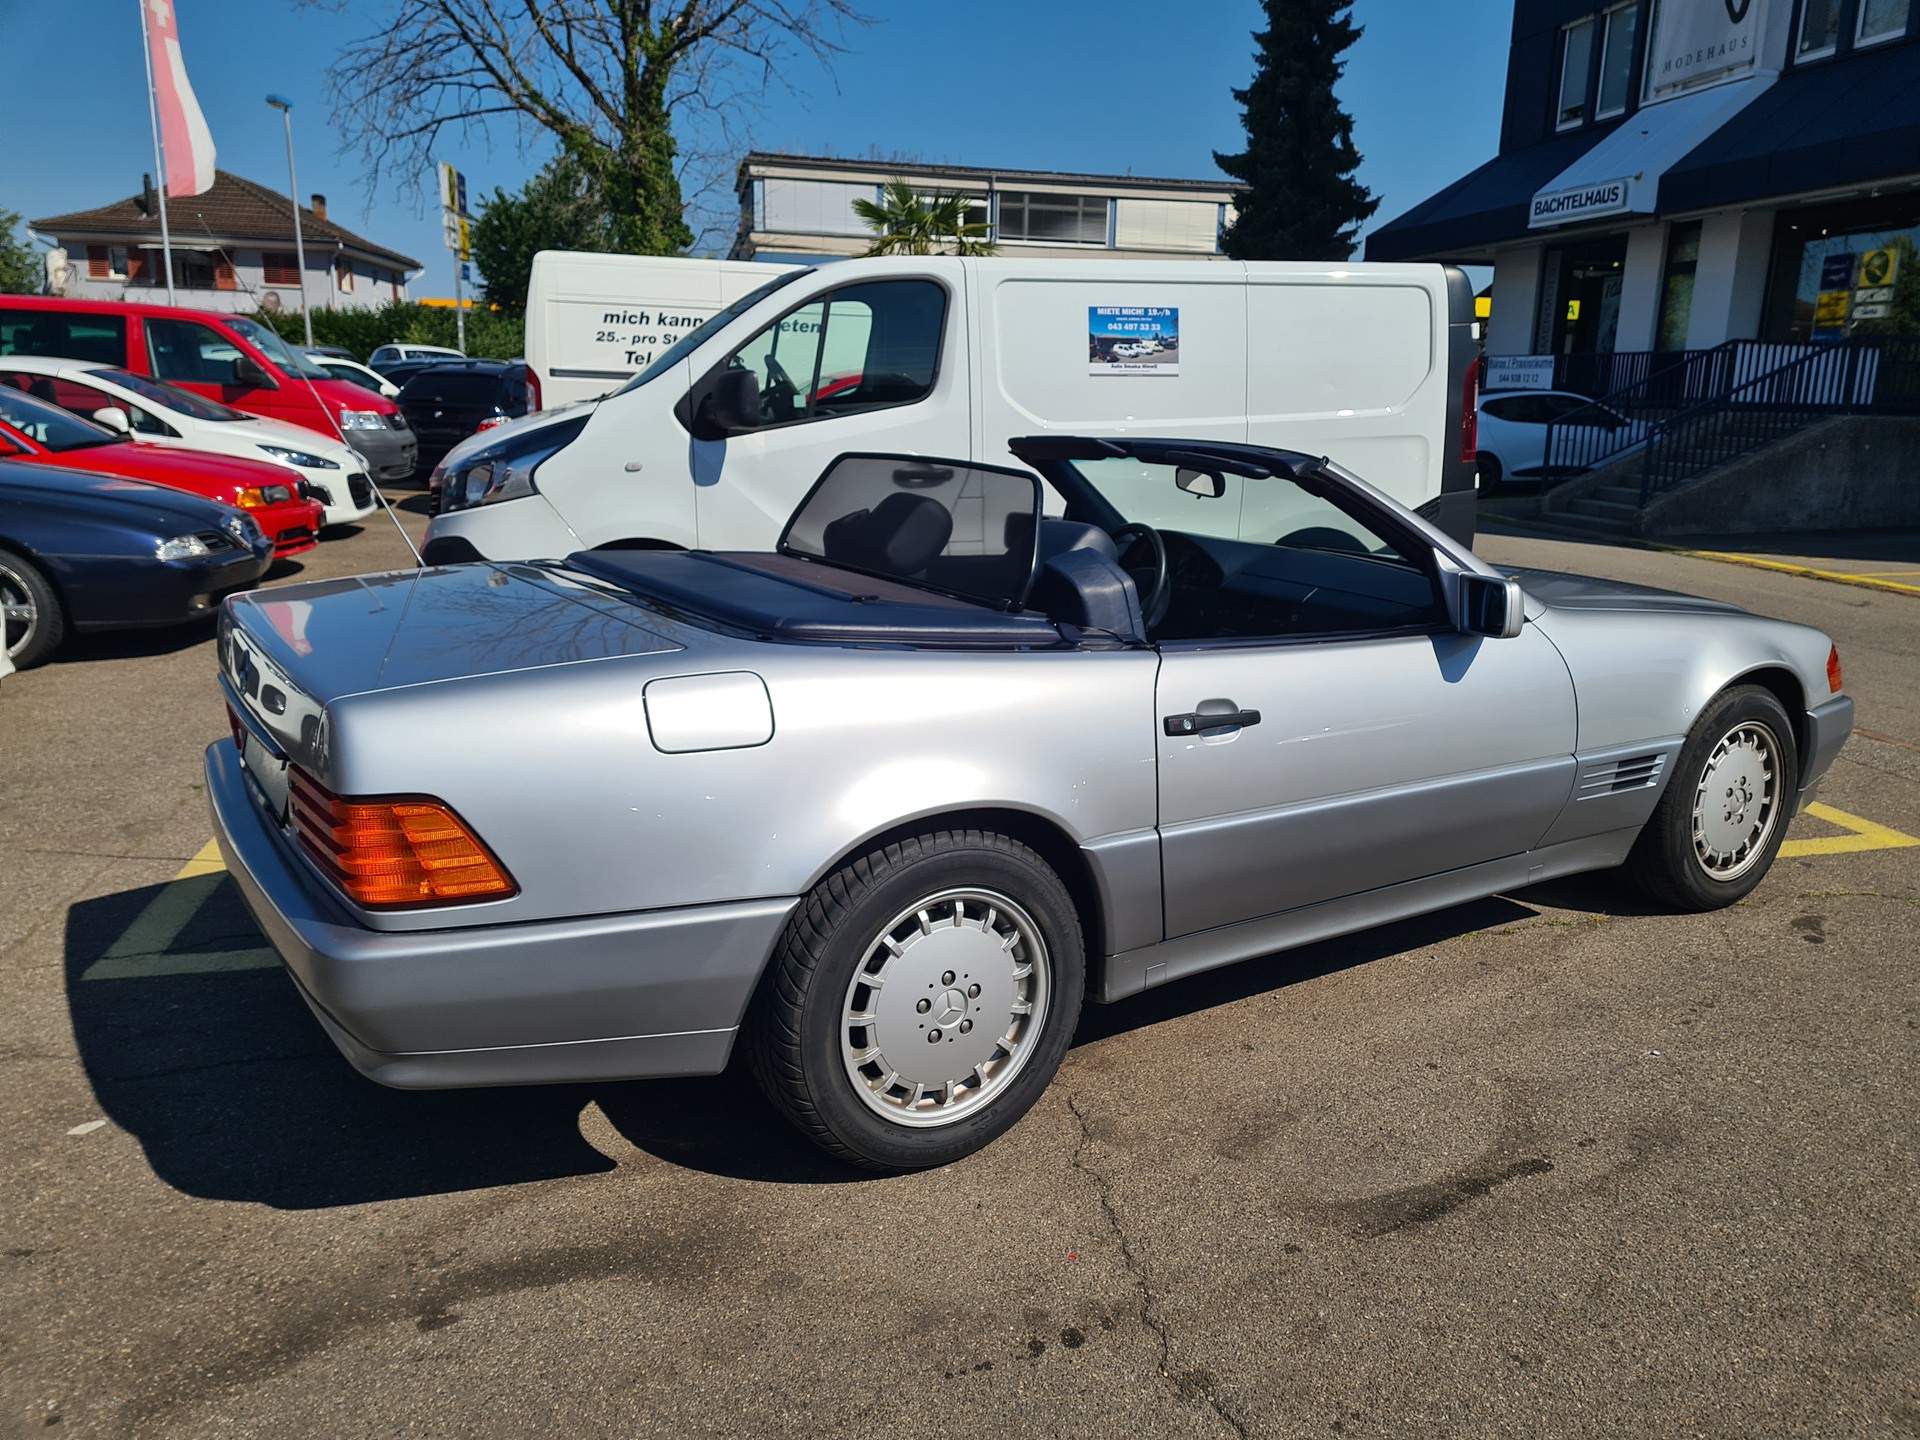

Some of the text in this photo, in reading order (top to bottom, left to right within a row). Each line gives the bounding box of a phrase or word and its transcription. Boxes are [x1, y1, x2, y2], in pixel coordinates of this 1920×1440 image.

[1663, 36, 1747, 73] MODEHAUS
[1534, 186, 1619, 216] BACHTELHAUS
[603, 310, 650, 325] mich
[1097, 307, 1120, 315] MIETE
[1122, 308, 1144, 316] MICH!
[1107, 323, 1161, 331] 043 497 33 33
[595, 331, 678, 346] 25.- pro St
